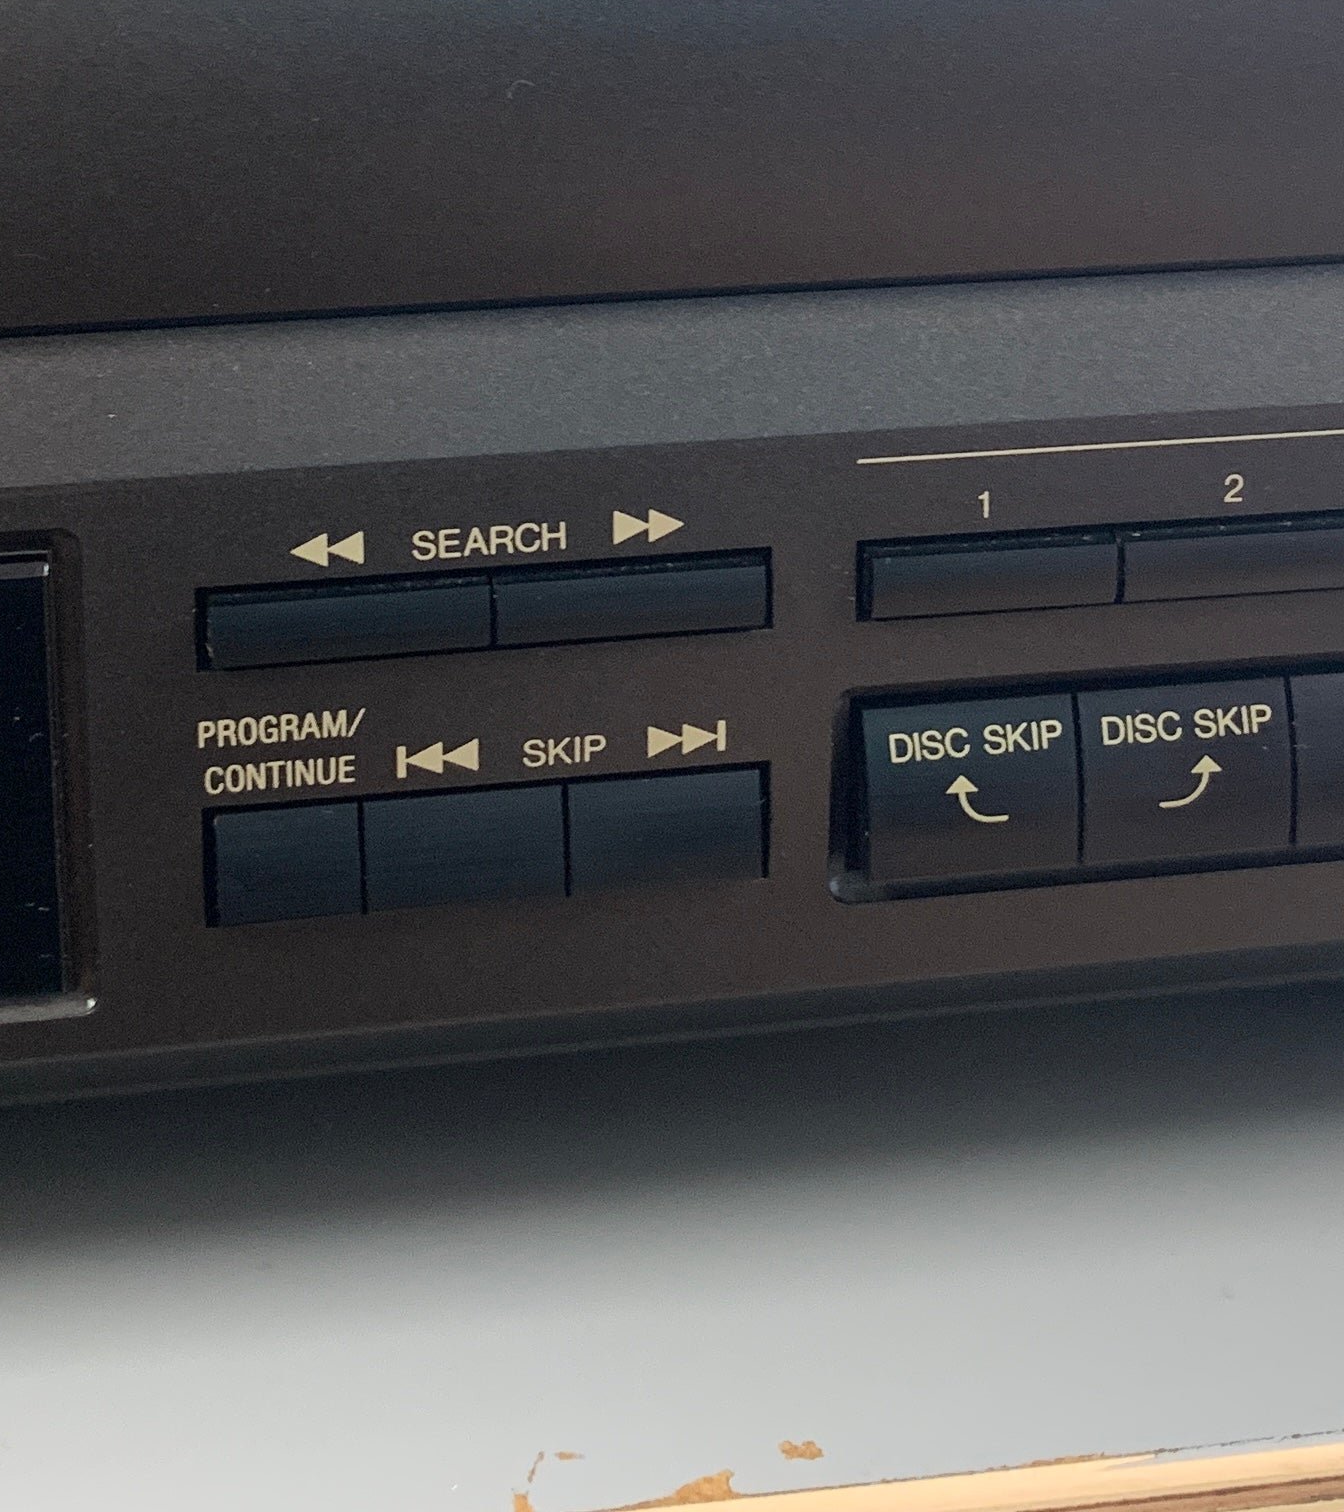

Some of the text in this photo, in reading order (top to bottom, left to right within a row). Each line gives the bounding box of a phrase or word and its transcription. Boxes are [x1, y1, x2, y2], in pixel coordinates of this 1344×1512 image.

[978, 492, 989, 517] 1
[1224, 475, 1242, 501] 2
[412, 522, 565, 559] SEARCH
[198, 708, 364, 747] PROGRAM/
[889, 720, 1061, 762] DISC SKIP
[1101, 705, 1271, 744] DISC SKIP
[523, 735, 605, 766] SKIP
[205, 755, 354, 793] CONTINUE
